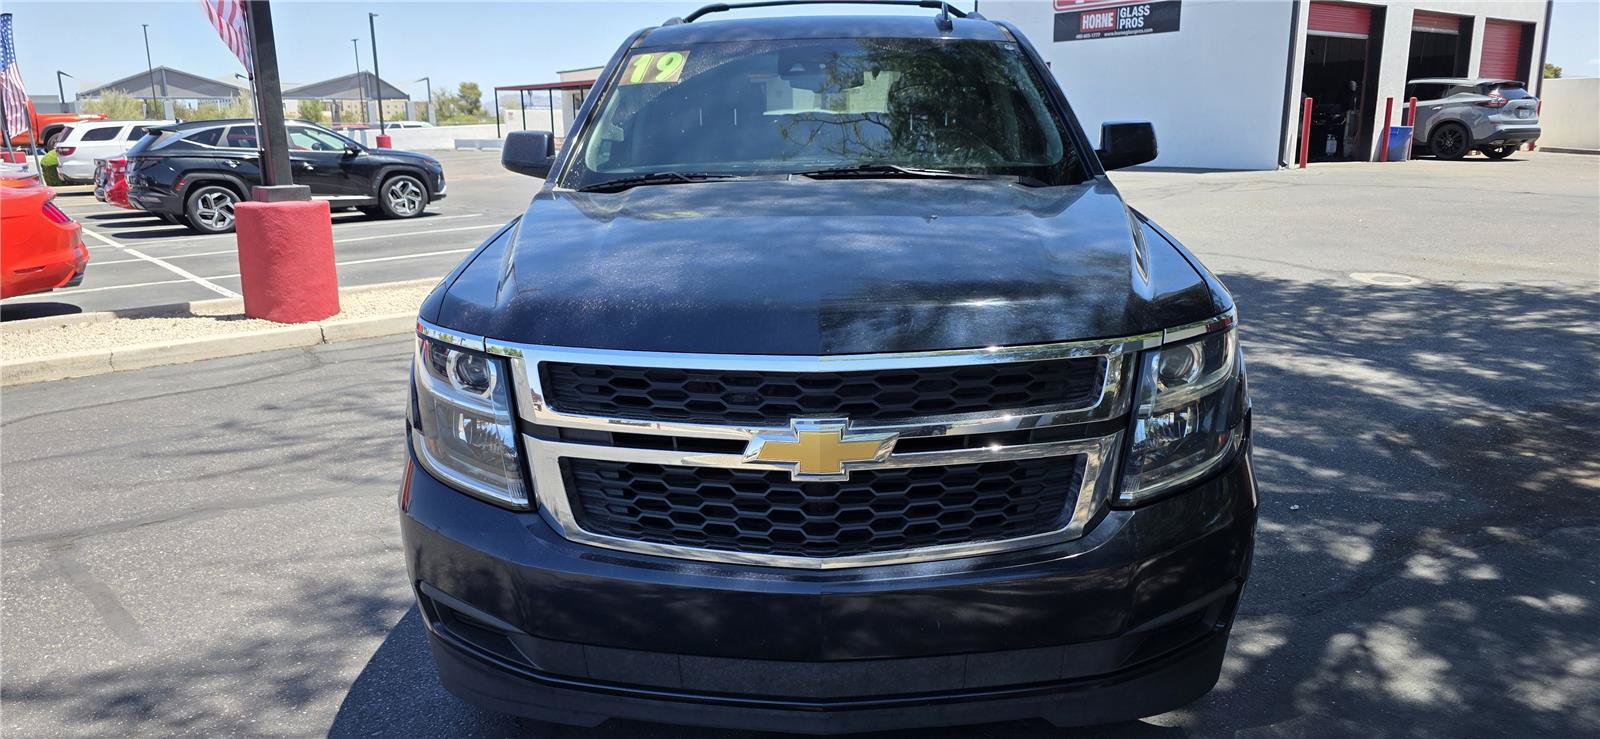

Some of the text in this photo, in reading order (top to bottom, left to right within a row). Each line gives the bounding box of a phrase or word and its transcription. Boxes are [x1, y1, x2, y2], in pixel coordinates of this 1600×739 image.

[1119, 5, 1151, 18] GLASS
[1082, 12, 1114, 30] HORNE
[1119, 17, 1144, 30] PROS
[630, 52, 684, 83] 19
